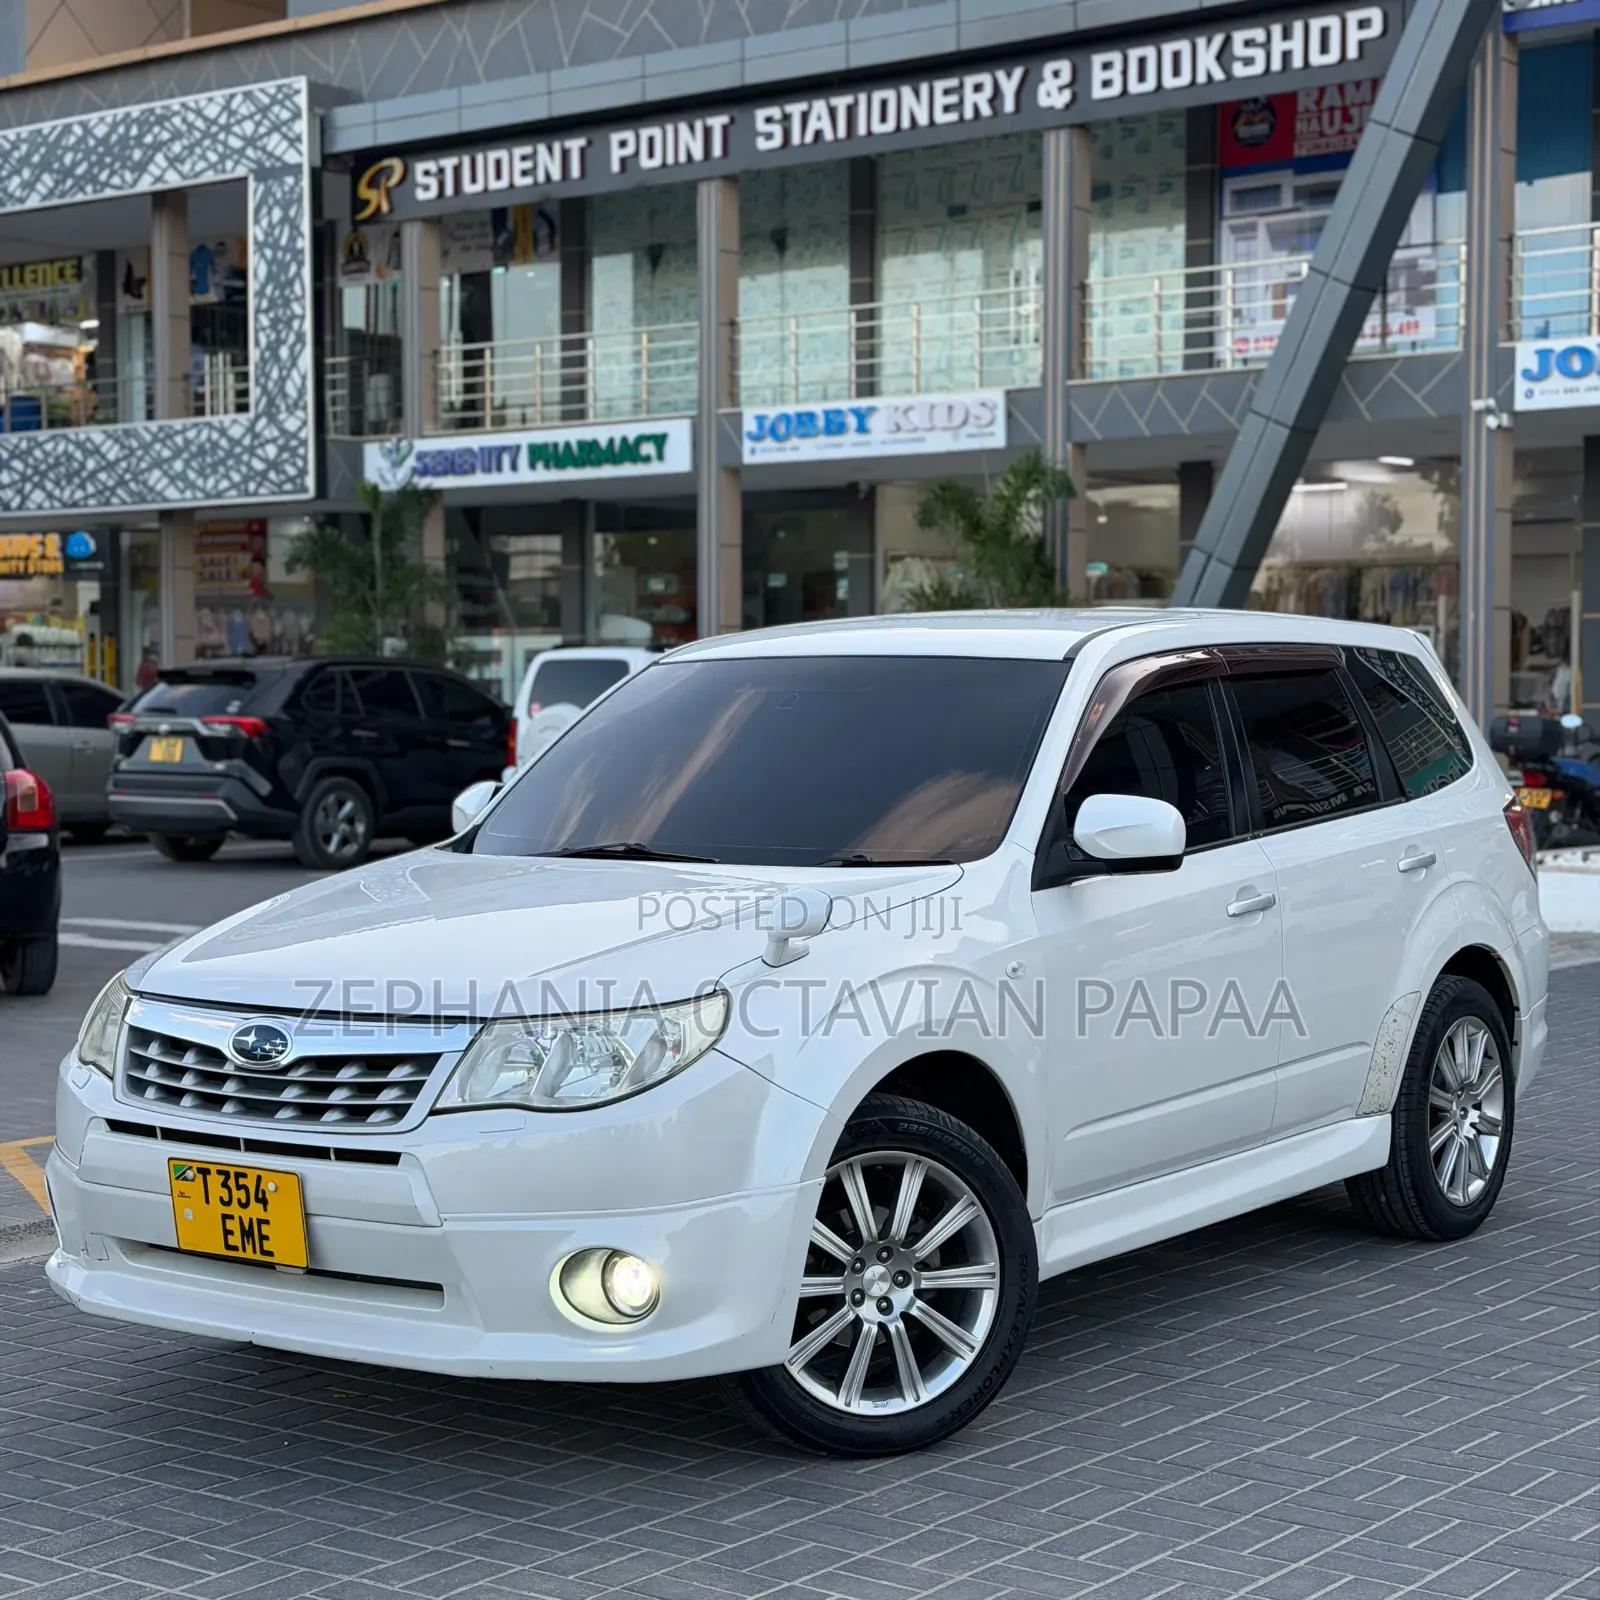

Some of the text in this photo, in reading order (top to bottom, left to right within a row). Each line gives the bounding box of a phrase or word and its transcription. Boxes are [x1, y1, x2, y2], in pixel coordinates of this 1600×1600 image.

[414, 6, 1386, 201] STUDENT POINT STATIONERY & BOOKSHOP
[1521, 344, 1600, 382] JO
[746, 399, 998, 442] JOBBY KIDS
[412, 433, 669, 477] SERENITY PHARMACY
[221, 1213, 275, 1258] EME
[1014, 1253, 1029, 1318] ROYAL
[950, 1325, 1020, 1420] EXPLORER
